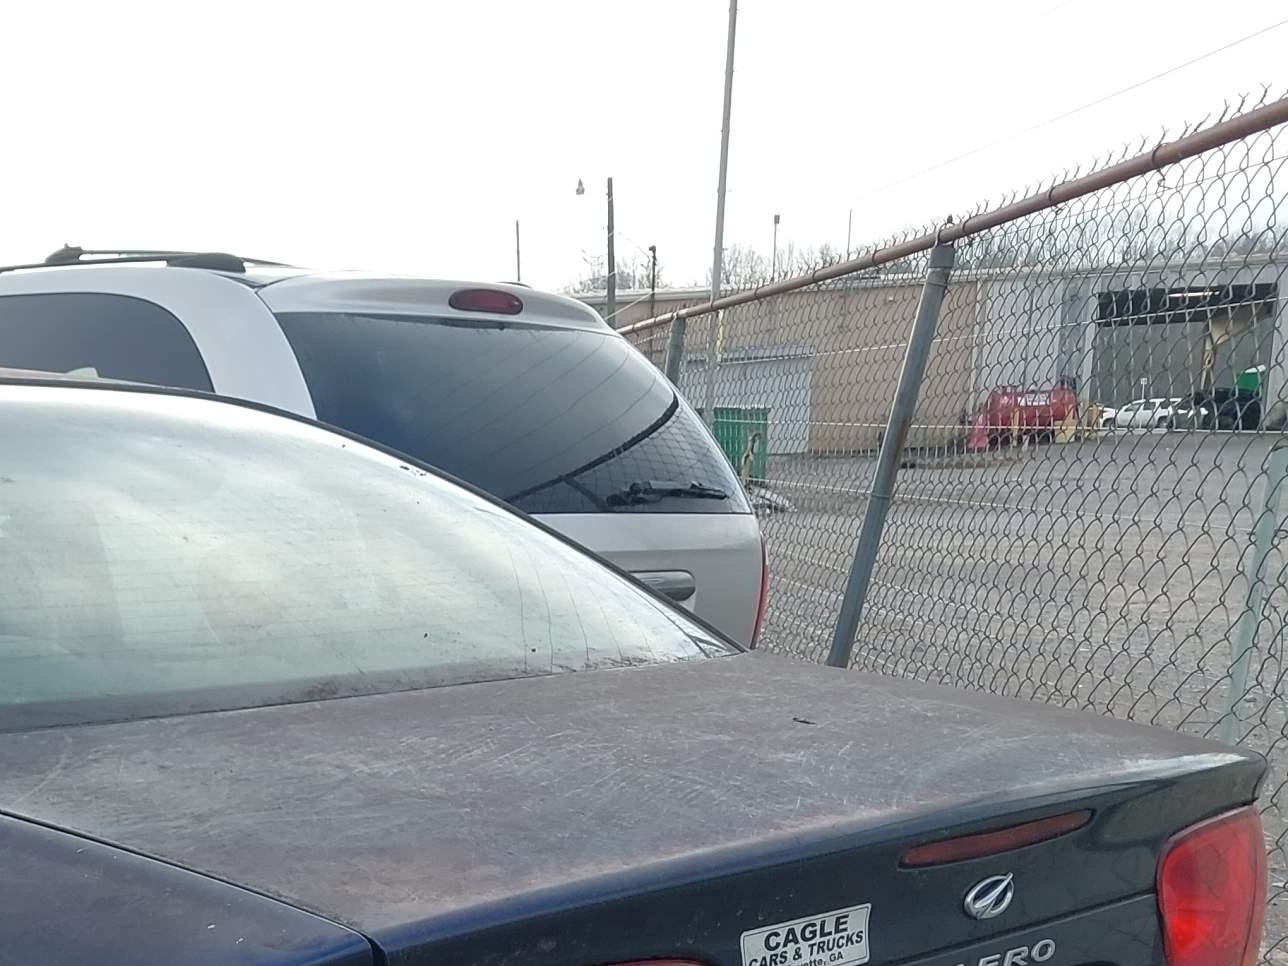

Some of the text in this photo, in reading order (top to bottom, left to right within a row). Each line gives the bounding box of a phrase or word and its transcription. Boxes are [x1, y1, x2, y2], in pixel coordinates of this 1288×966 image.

[764, 913, 850, 952] CAGLE
[792, 946, 803, 962] &
[808, 930, 864, 957] TRUCKS
[829, 951, 844, 963] GA
